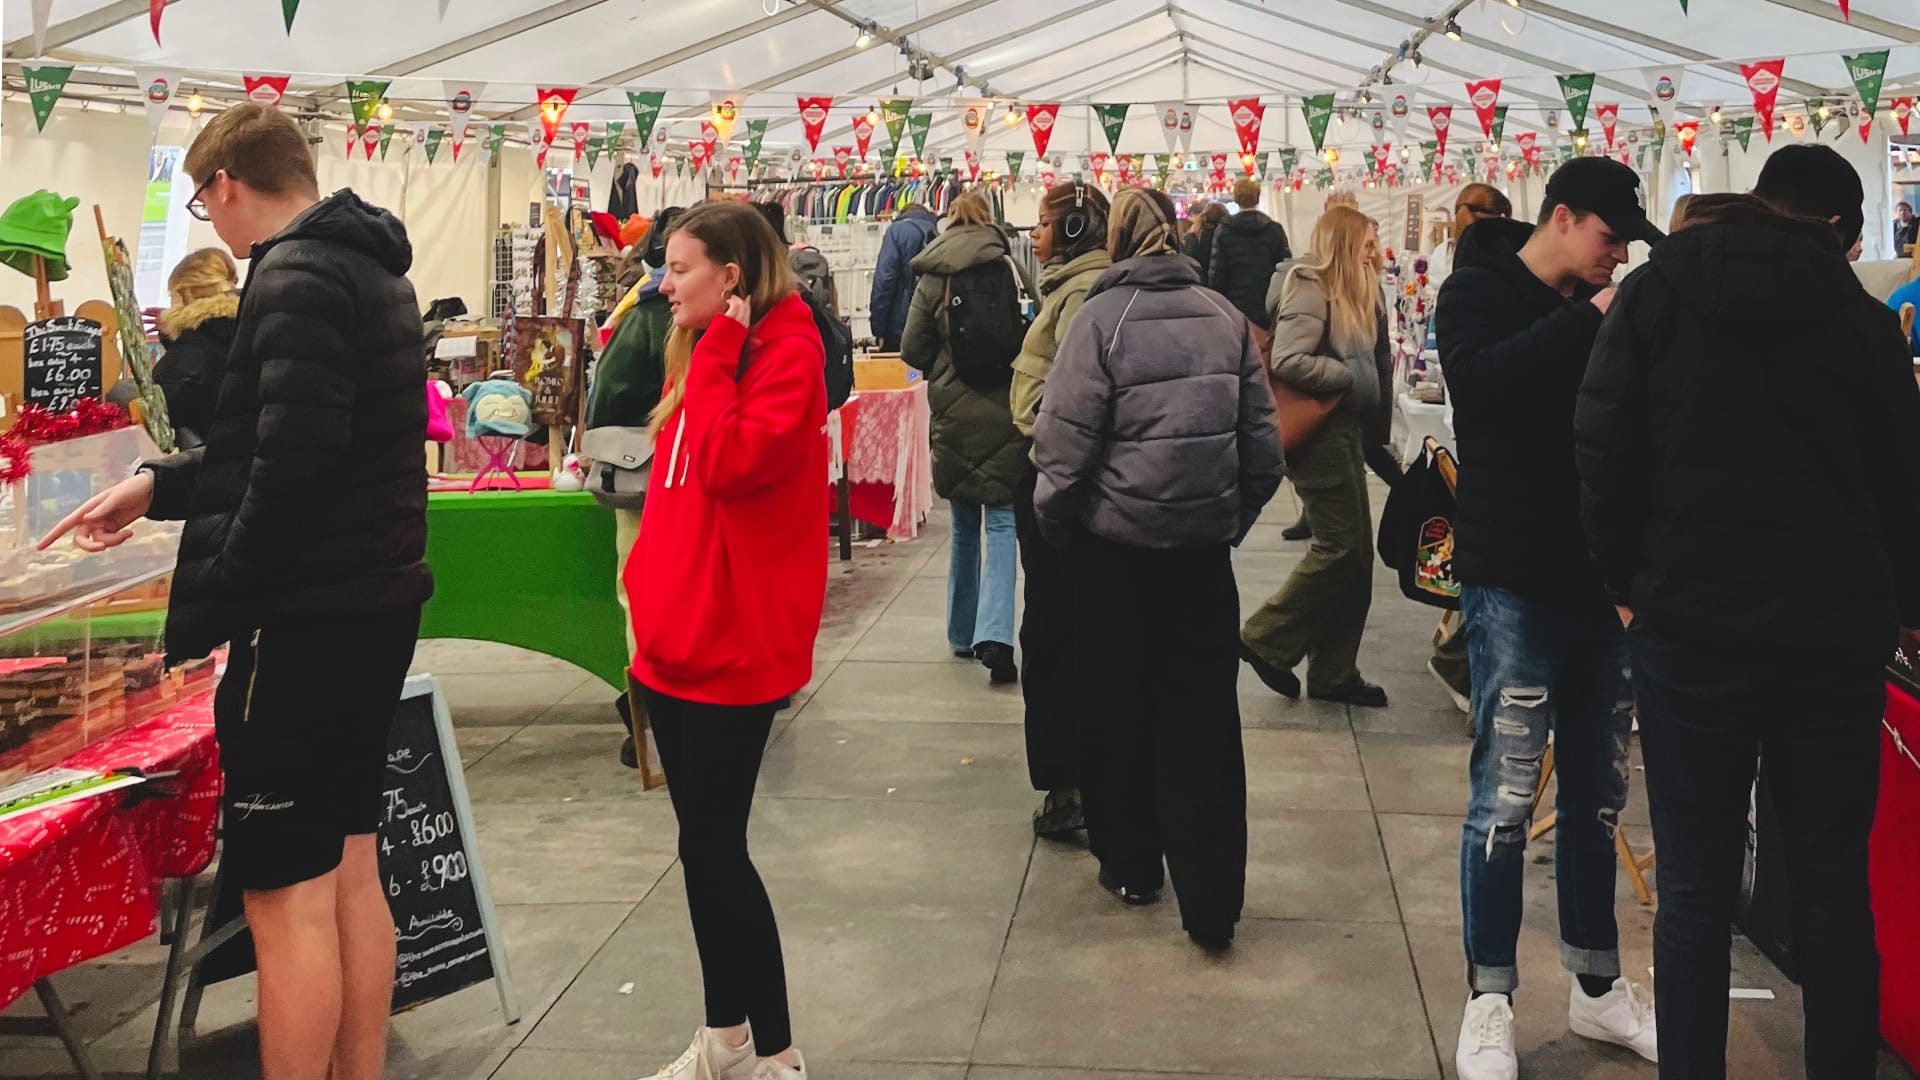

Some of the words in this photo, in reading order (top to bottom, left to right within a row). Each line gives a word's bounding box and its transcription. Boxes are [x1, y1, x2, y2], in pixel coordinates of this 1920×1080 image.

[69, 353, 83, 364] 4
[45, 368, 91, 383] £6.00
[77, 380, 87, 395] 6
[47, 395, 80, 412] £9.0
